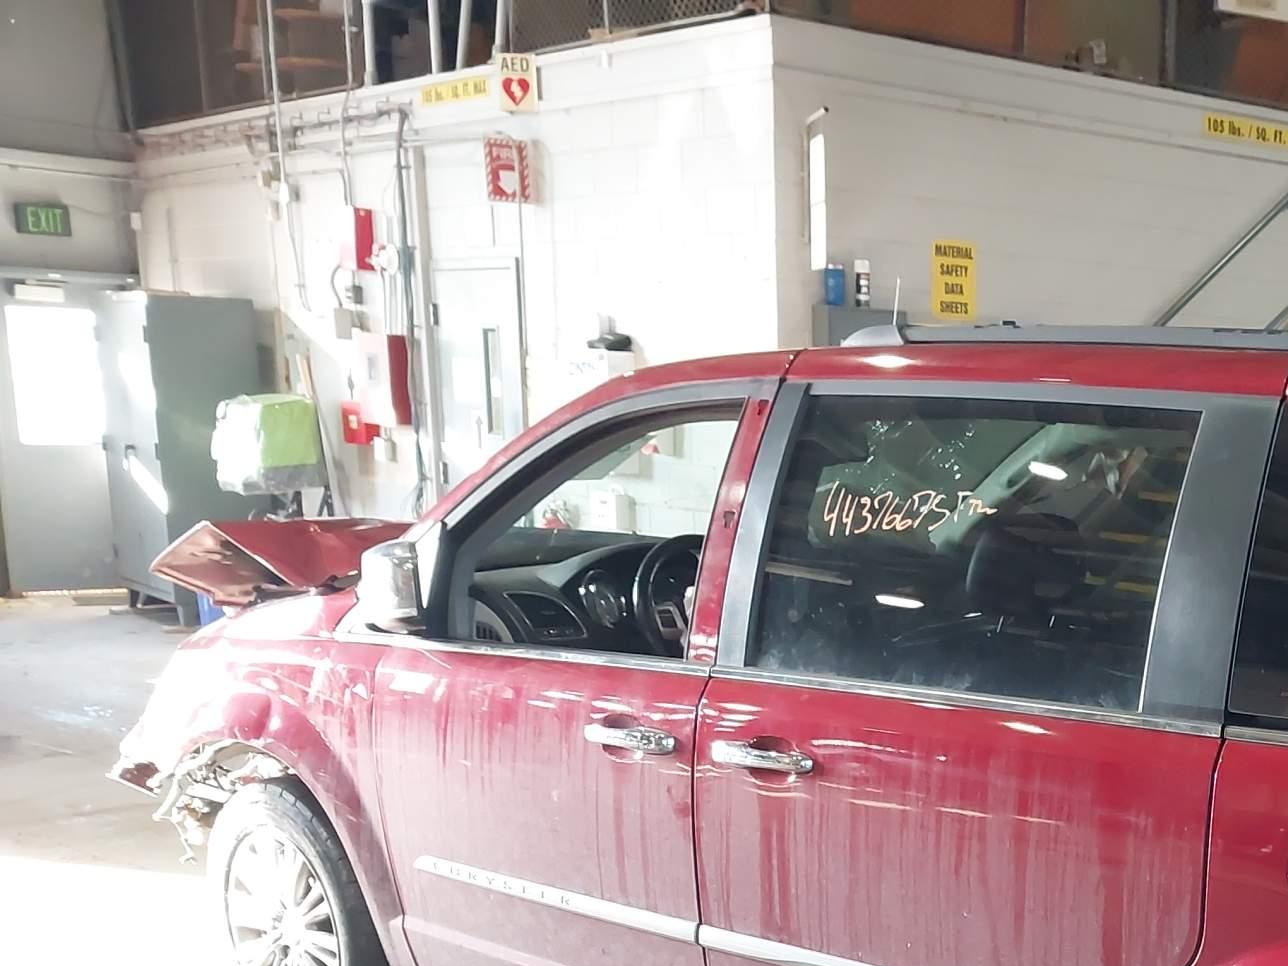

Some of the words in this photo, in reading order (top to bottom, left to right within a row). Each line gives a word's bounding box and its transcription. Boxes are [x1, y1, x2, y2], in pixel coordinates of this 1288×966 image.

[501, 56, 530, 72] AED
[1207, 117, 1225, 134] 105
[1228, 120, 1245, 137] lbs.
[1256, 126, 1271, 142] SQ.
[1274, 129, 1287, 144] FT.
[27, 206, 64, 233] EXIT
[935, 244, 974, 260] MATERIAL
[940, 262, 969, 278] SAFETY
[944, 282, 965, 297] DATA
[940, 300, 969, 315] SHEETS
[823, 480, 950, 537] 44376675
